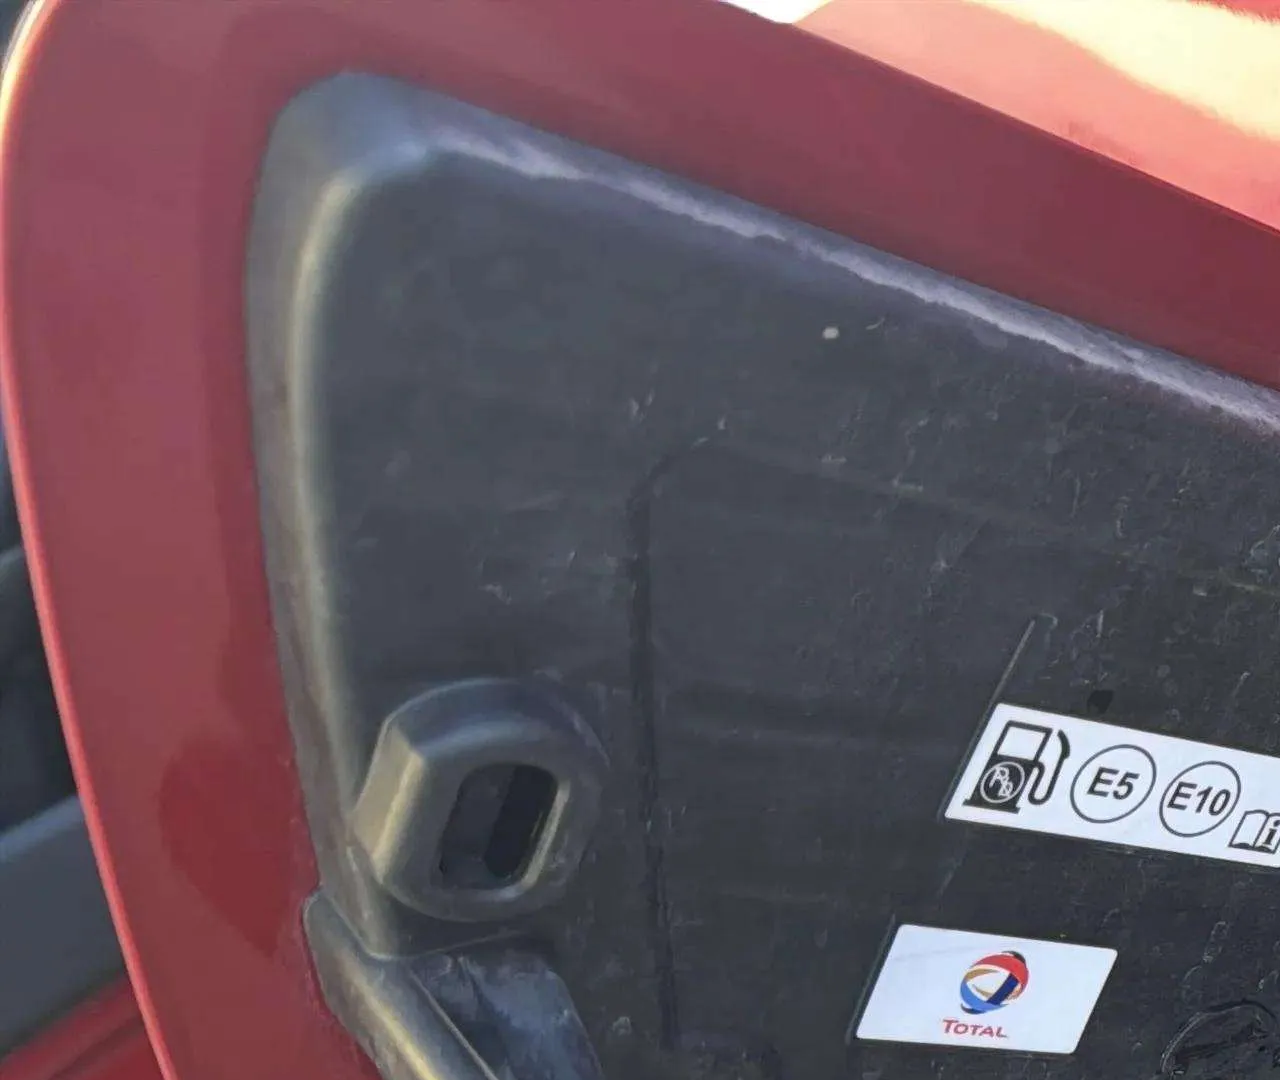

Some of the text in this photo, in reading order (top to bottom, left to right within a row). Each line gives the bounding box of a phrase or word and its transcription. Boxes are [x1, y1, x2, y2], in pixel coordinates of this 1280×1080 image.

[1086, 766, 1141, 801] E5
[1166, 780, 1232, 817] E10
[942, 1018, 1009, 1039] TOTAL
